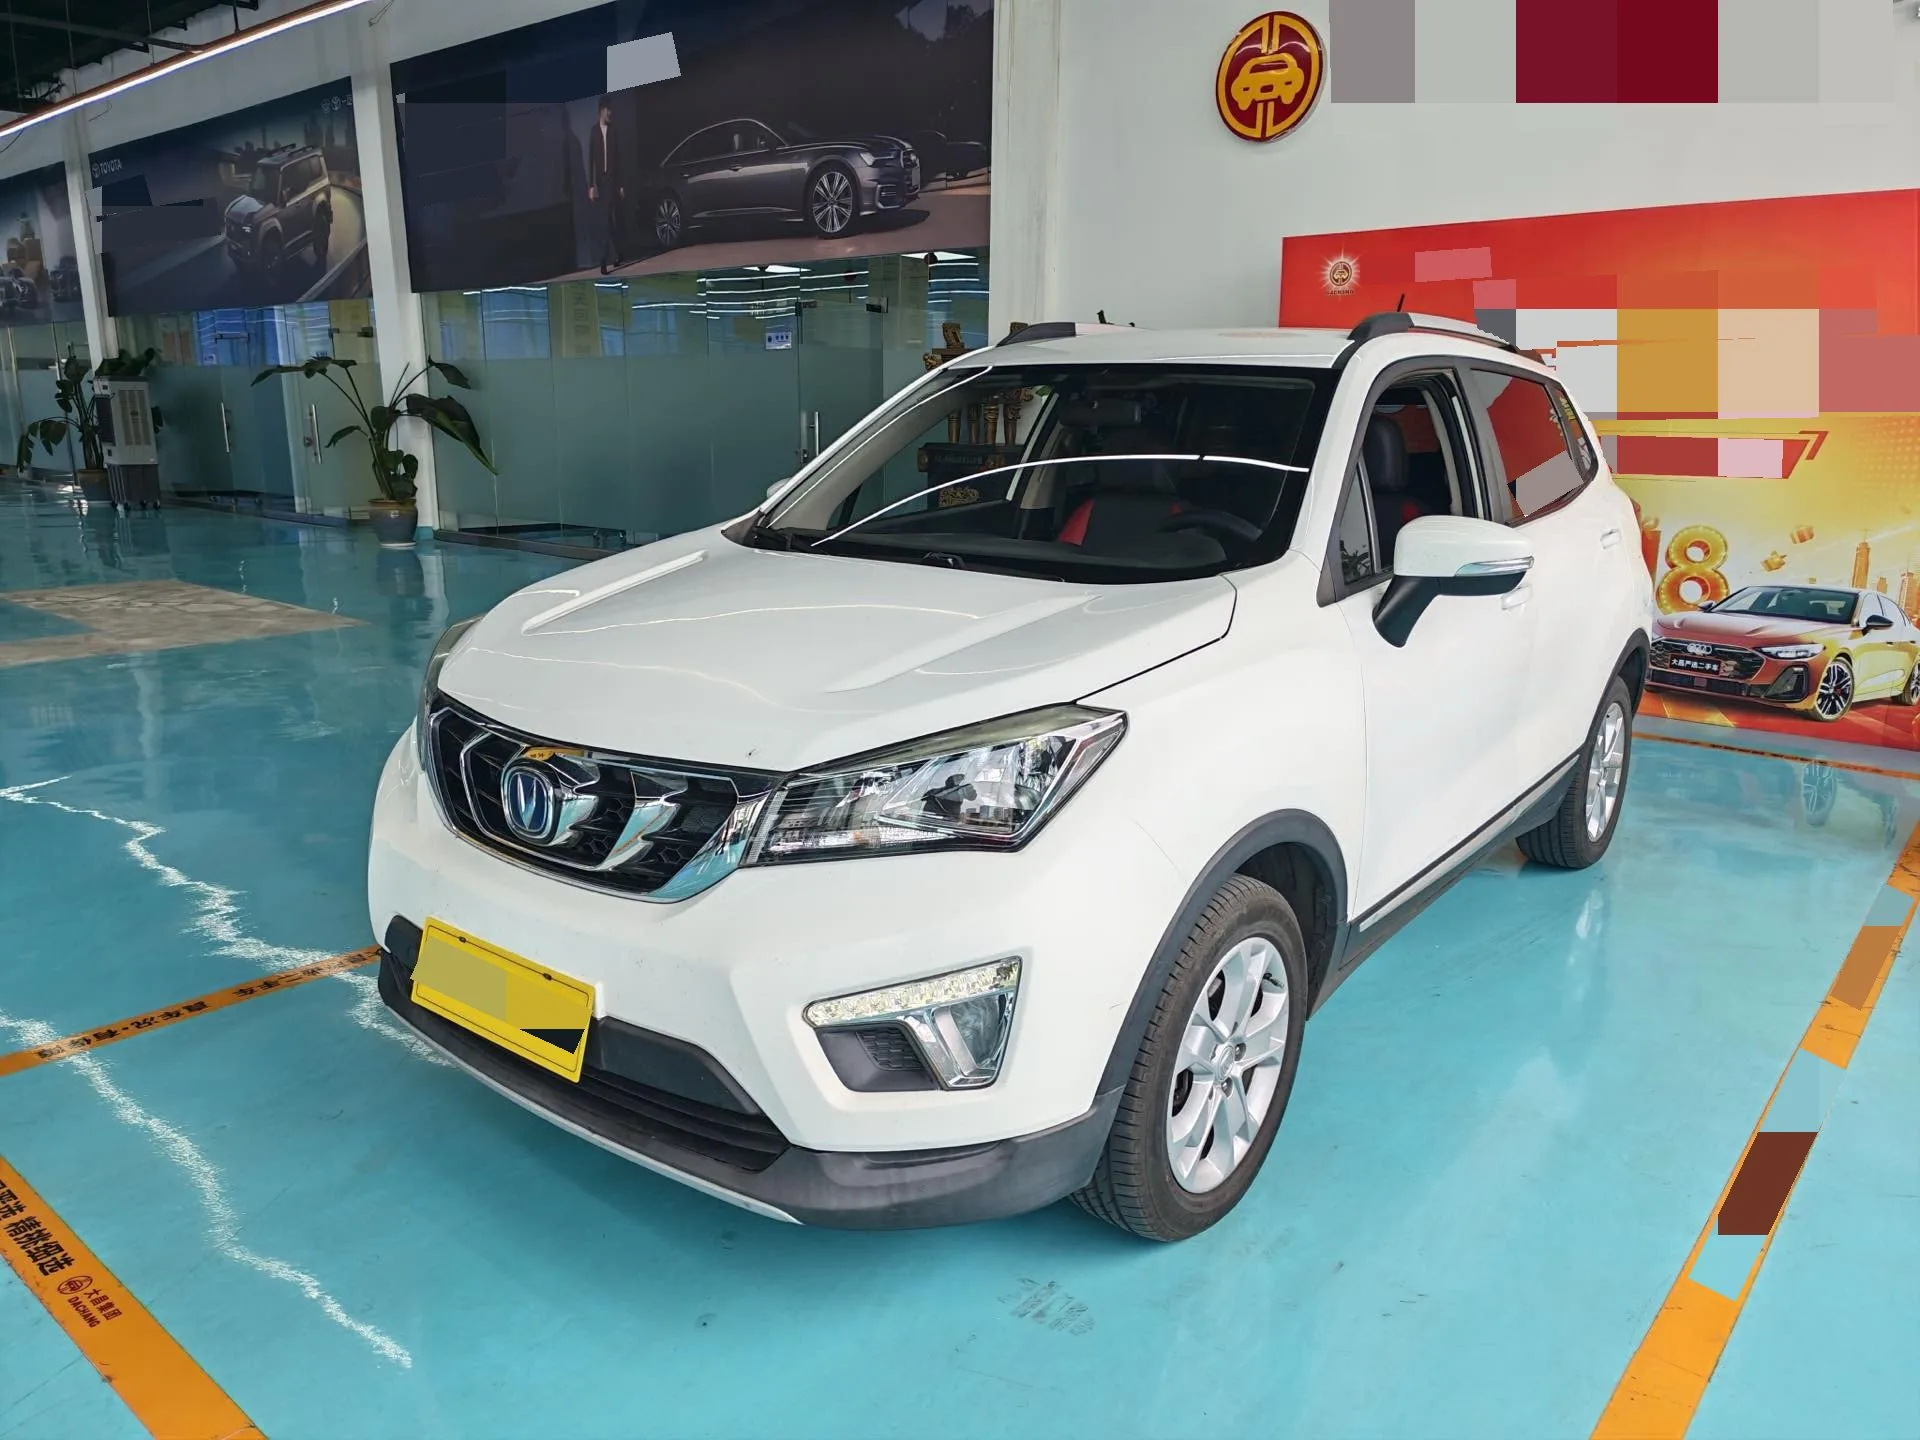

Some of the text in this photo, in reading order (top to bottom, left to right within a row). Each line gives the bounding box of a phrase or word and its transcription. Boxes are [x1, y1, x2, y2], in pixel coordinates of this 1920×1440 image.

[100, 159, 122, 174] TOYOTA
[3, 1215, 75, 1276] 精挑细选
[68, 1297, 100, 1328] DACHANG
[84, 1289, 122, 1320] 大昌集团
